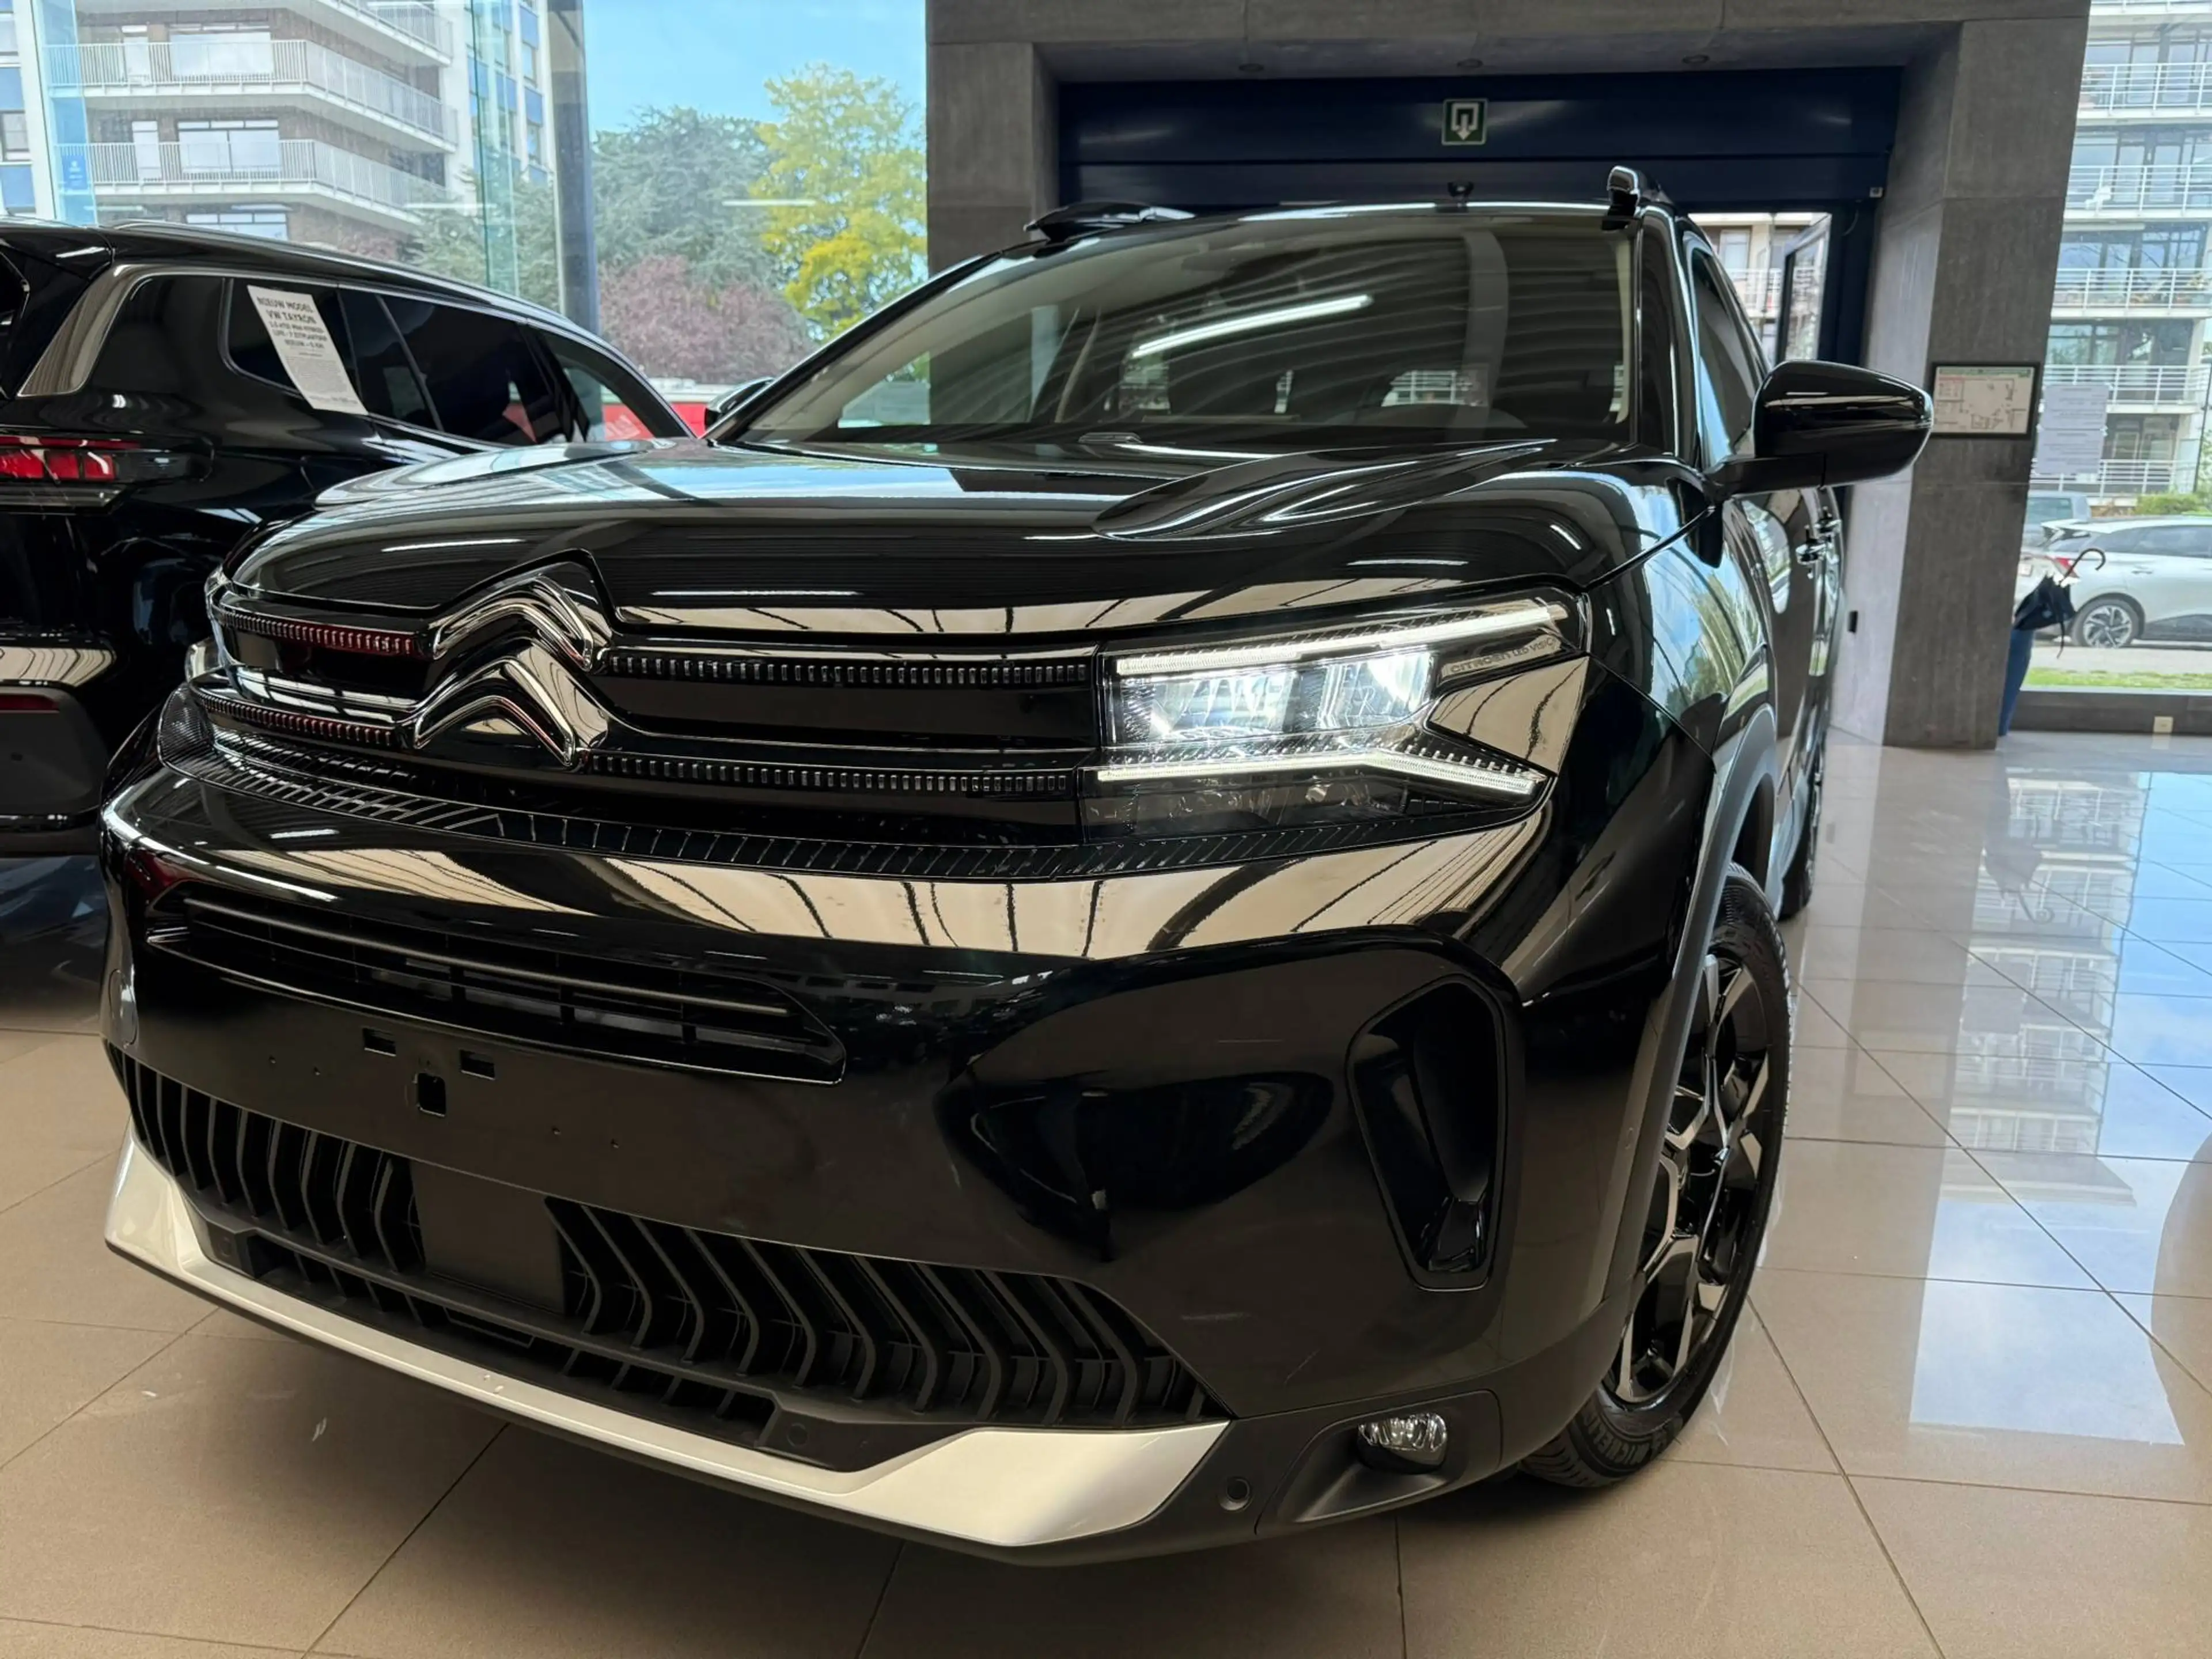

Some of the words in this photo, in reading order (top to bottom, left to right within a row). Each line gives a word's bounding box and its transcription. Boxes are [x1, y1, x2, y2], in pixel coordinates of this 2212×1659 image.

[257, 297, 285, 308] NIEUW
[286, 302, 313, 313] MODEL
[266, 309, 281, 319] VW
[282, 312, 316, 324] TAYRON
